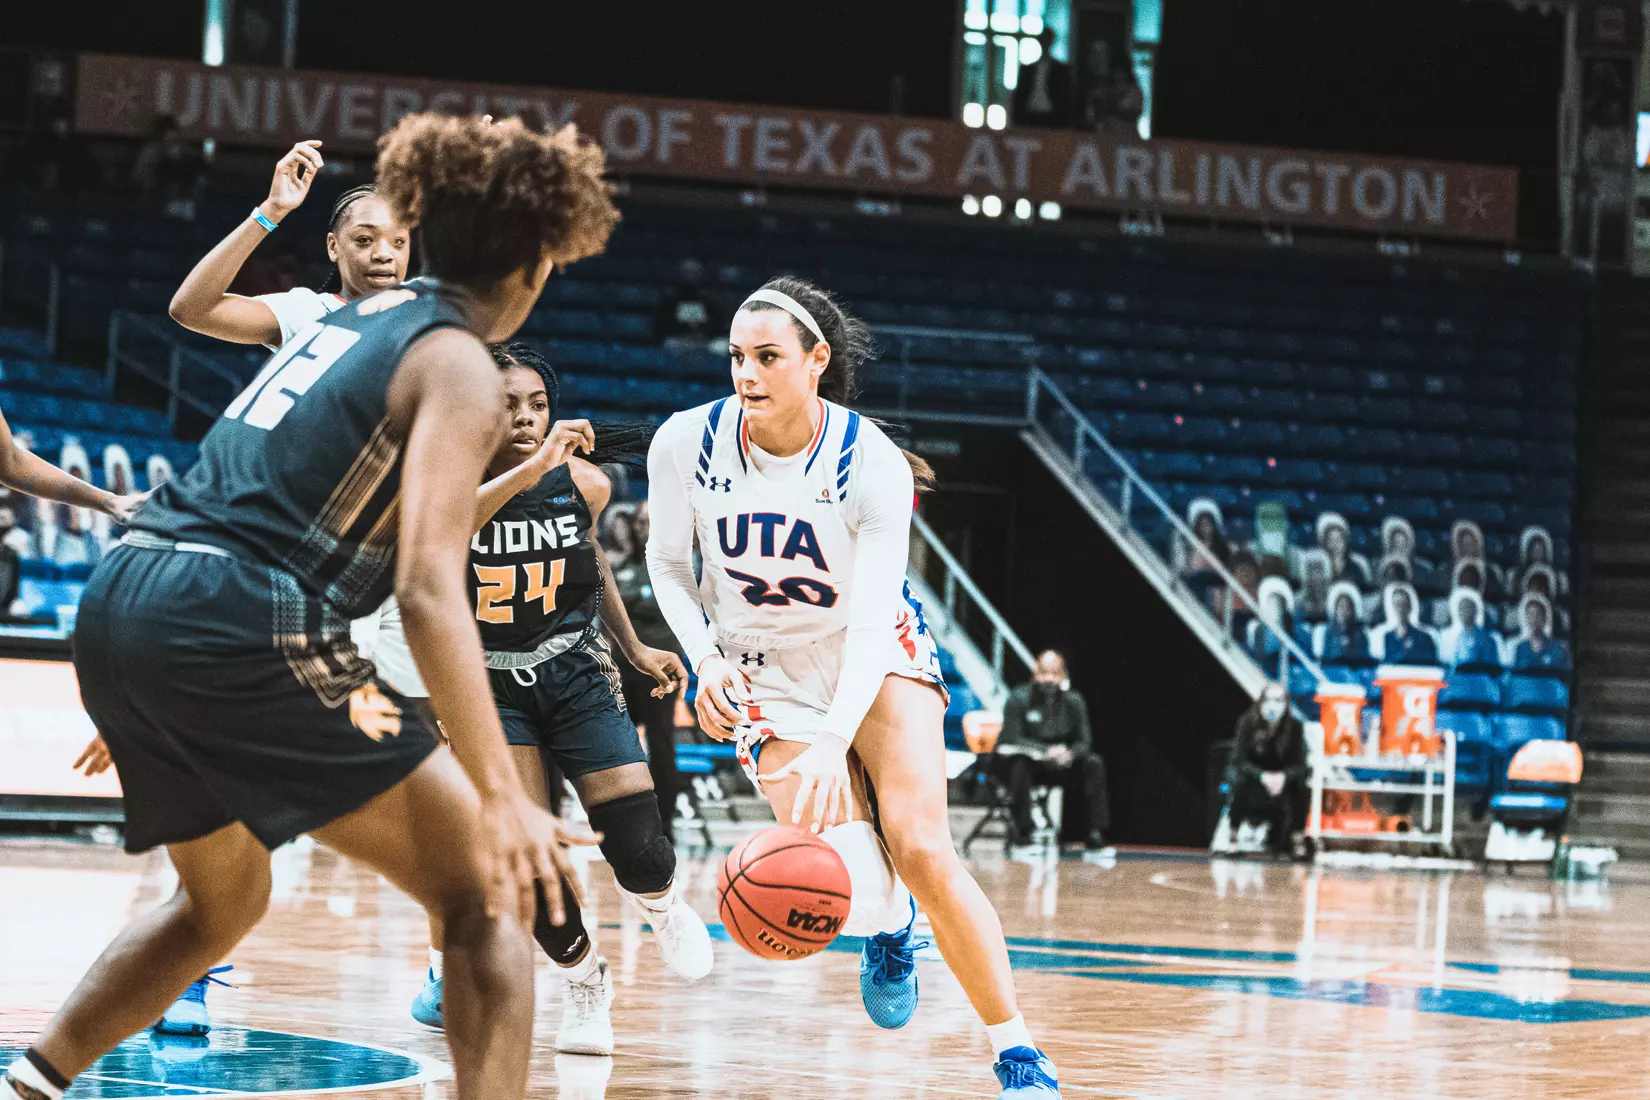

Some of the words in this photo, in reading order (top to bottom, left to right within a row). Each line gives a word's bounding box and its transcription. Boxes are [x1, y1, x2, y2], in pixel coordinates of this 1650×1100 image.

[602, 104, 694, 162] OF
[713, 113, 935, 182] TEXAS
[957, 133, 1043, 191] AT
[1060, 139, 1447, 224] ARLINGTON
[223, 321, 362, 431] 12
[470, 513, 581, 555] LIONS
[716, 511, 832, 574] UTA
[472, 557, 567, 625] 24
[723, 566, 840, 609] 20
[786, 908, 844, 934] NCAA
